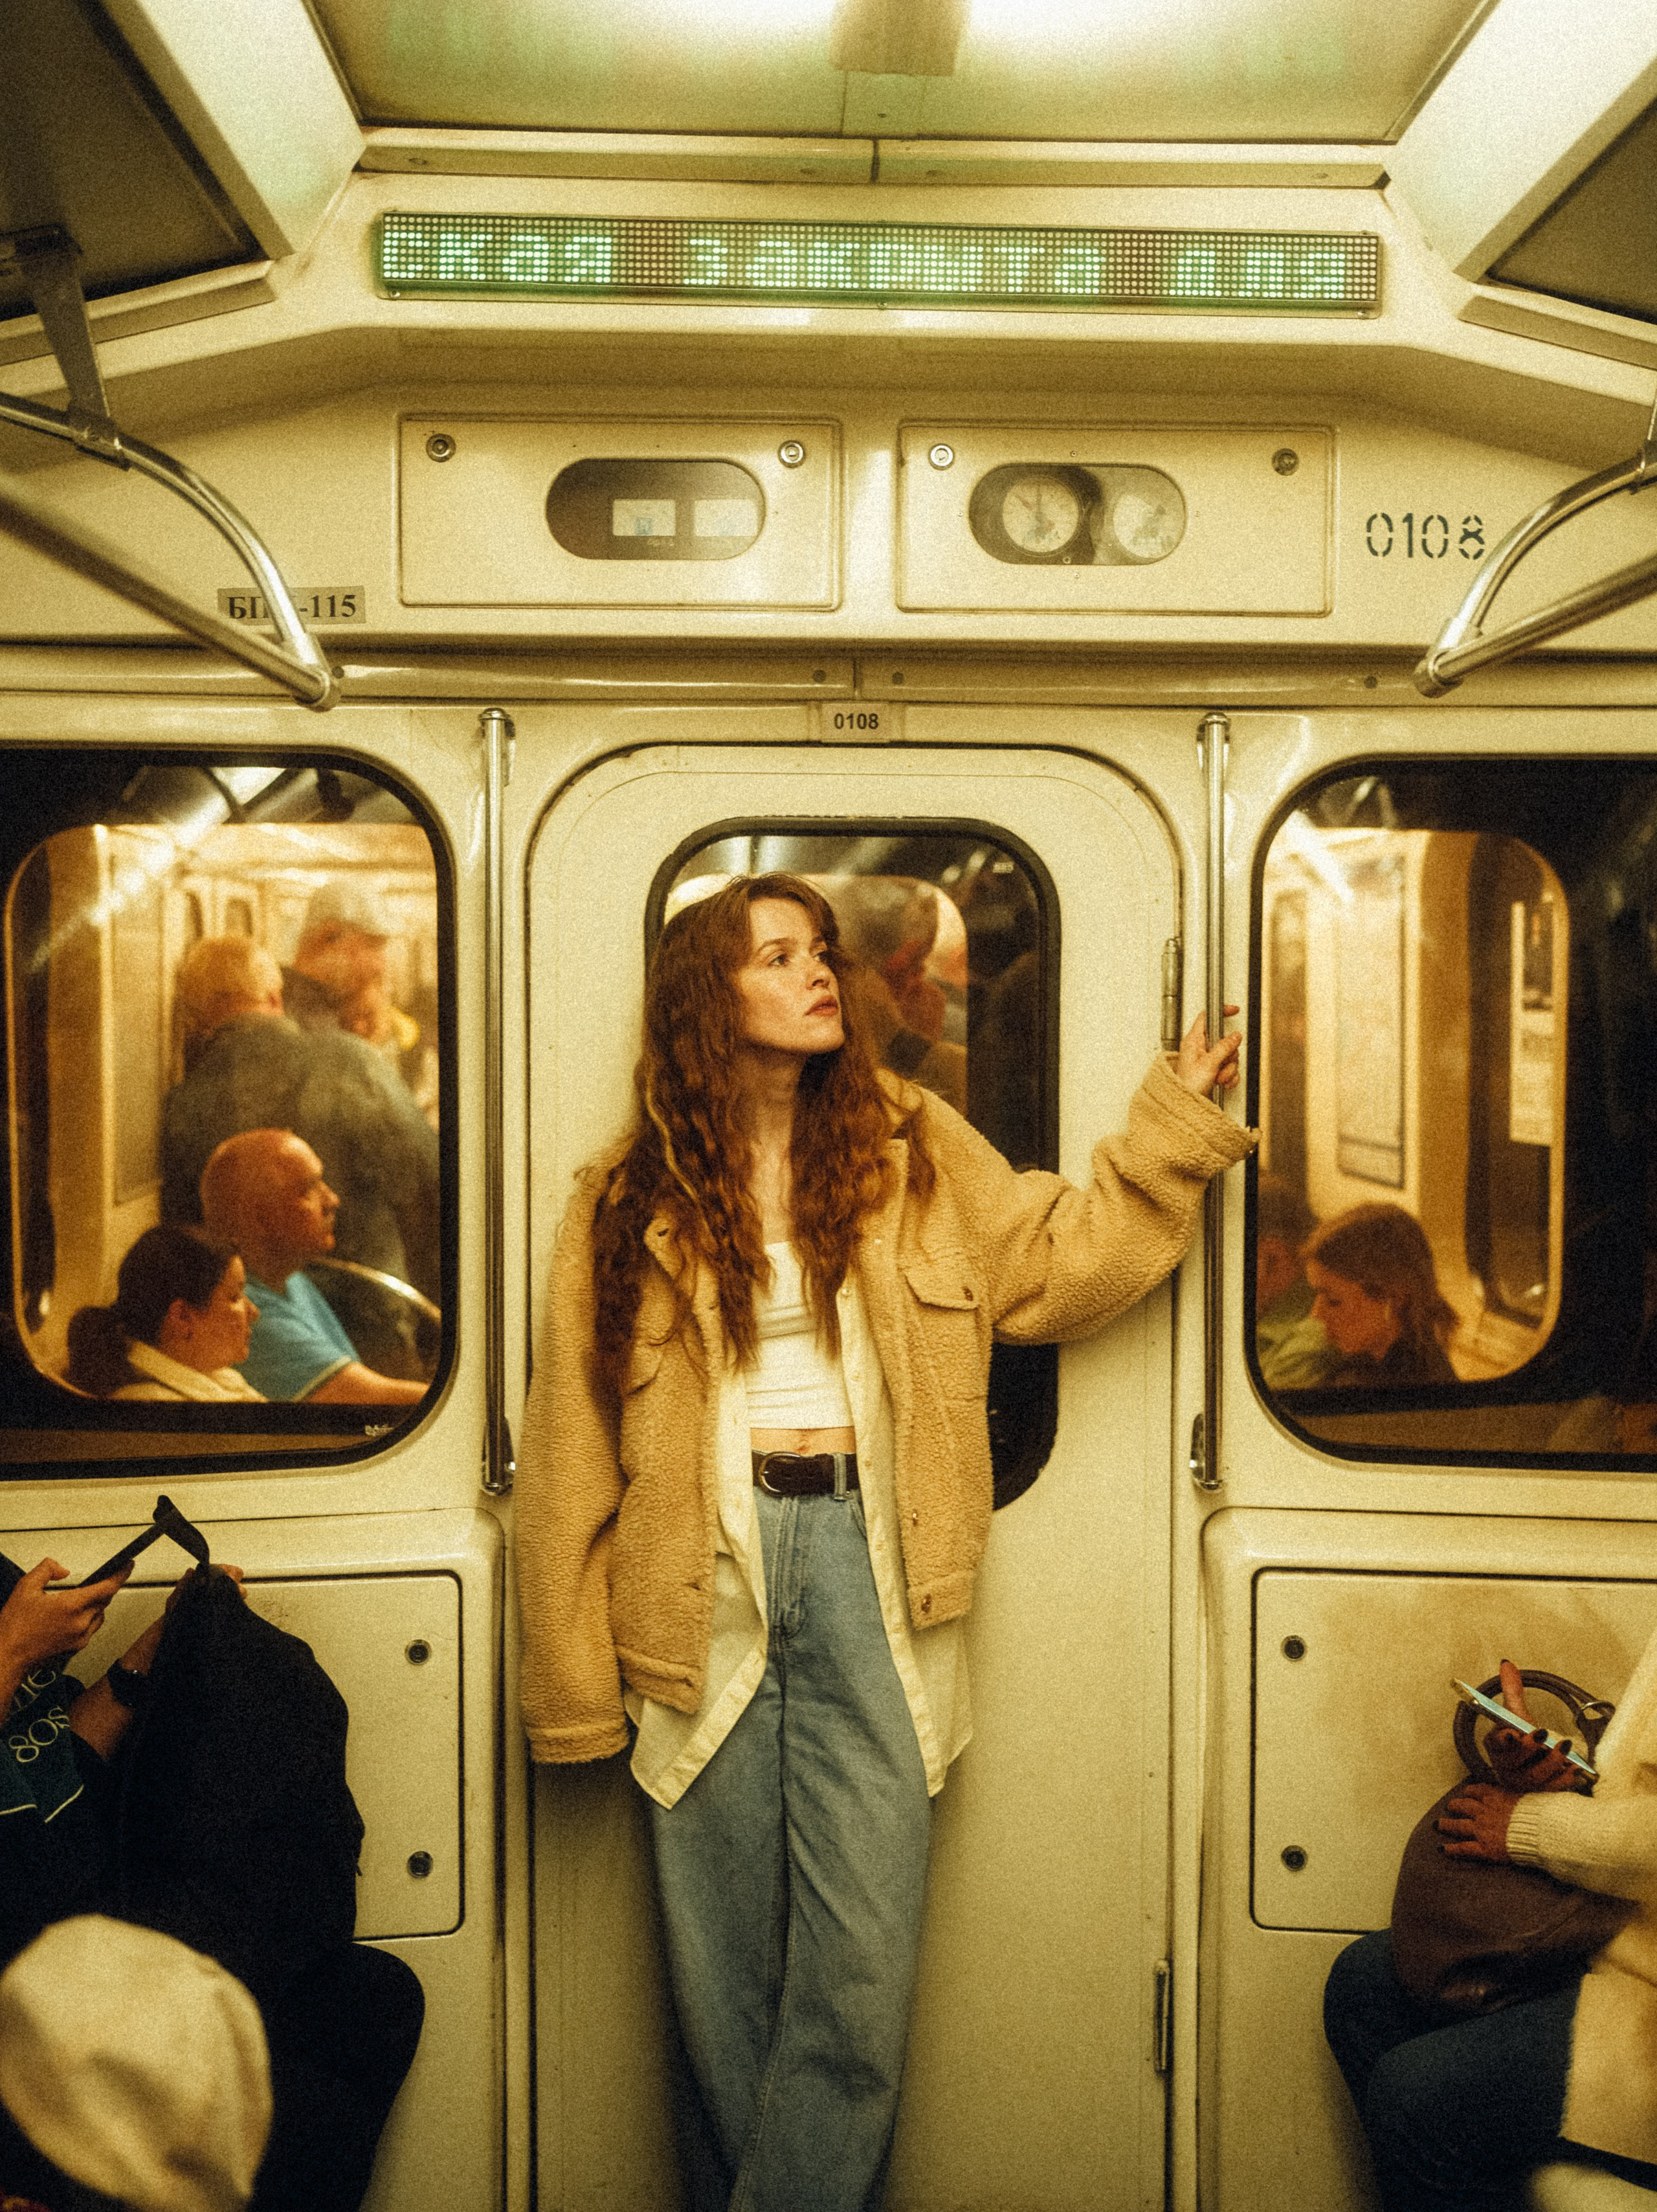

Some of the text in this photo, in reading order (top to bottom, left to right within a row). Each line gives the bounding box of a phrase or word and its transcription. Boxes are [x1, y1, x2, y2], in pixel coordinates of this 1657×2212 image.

[684, 239, 1106, 294] закрыта
[1168, 250, 1346, 299] для
[1366, 512, 1485, 561] 0108
[226, 594, 357, 619] БП-115
[834, 713, 880, 730] 0108
